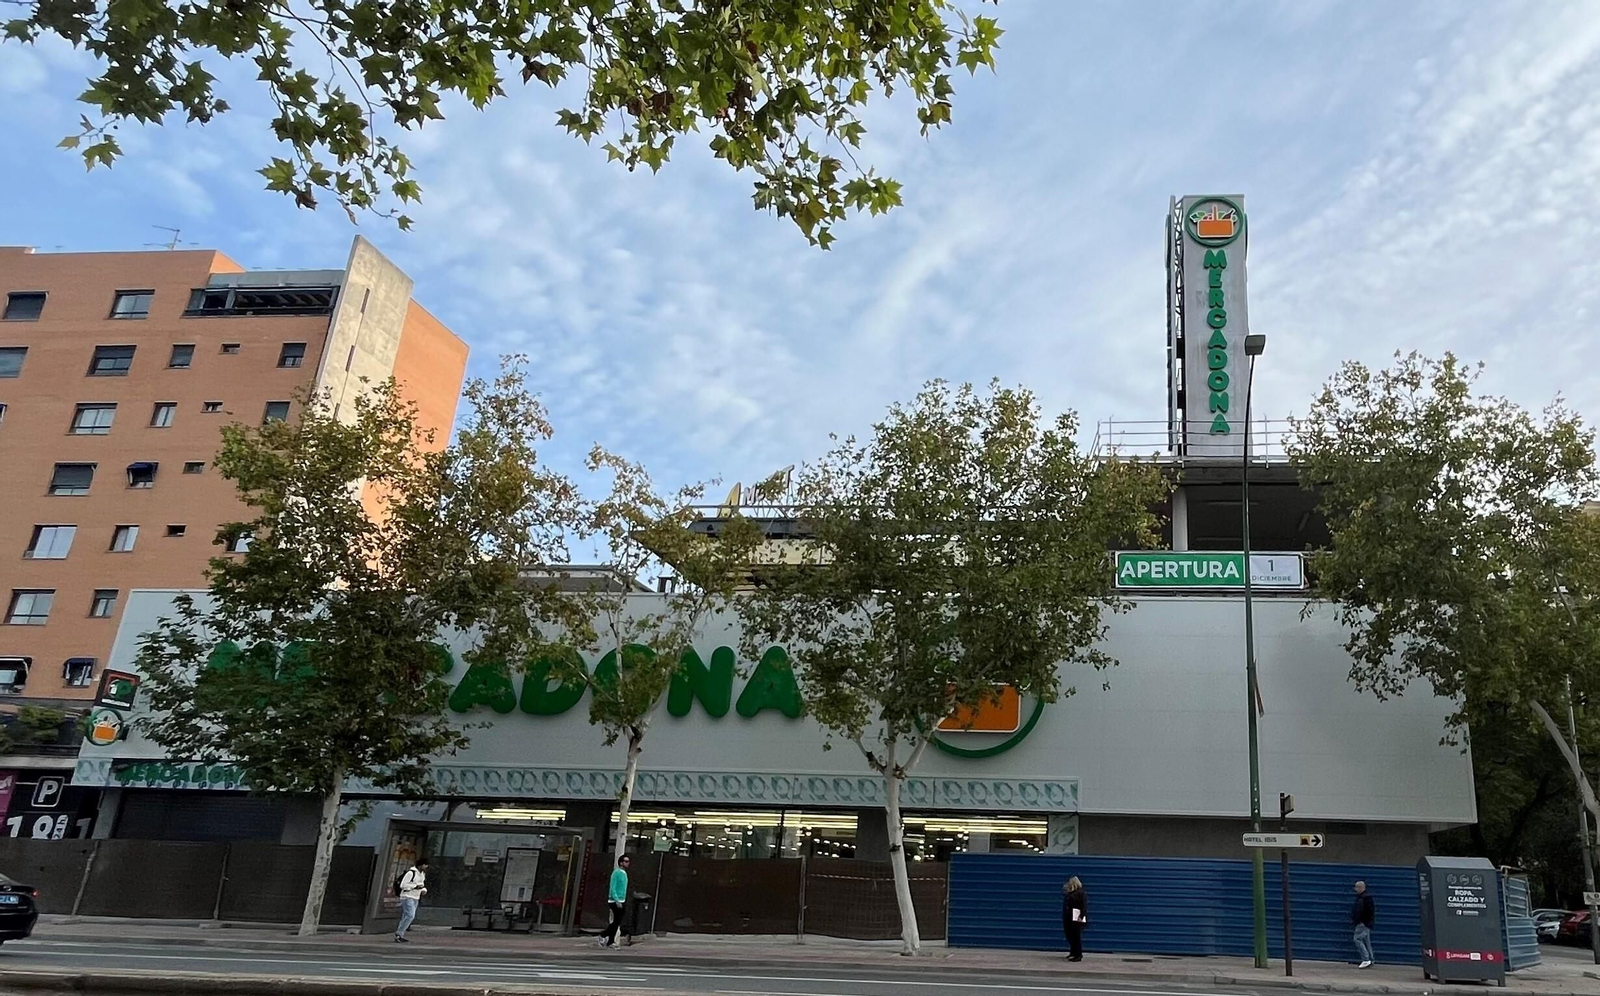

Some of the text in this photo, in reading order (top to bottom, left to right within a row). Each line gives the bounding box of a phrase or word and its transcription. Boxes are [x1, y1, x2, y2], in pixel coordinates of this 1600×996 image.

[1203, 249, 1231, 435] MERCADONA
[1120, 560, 1240, 578] APERTURA
[1267, 559, 1274, 572] 1
[38, 780, 59, 803] P
